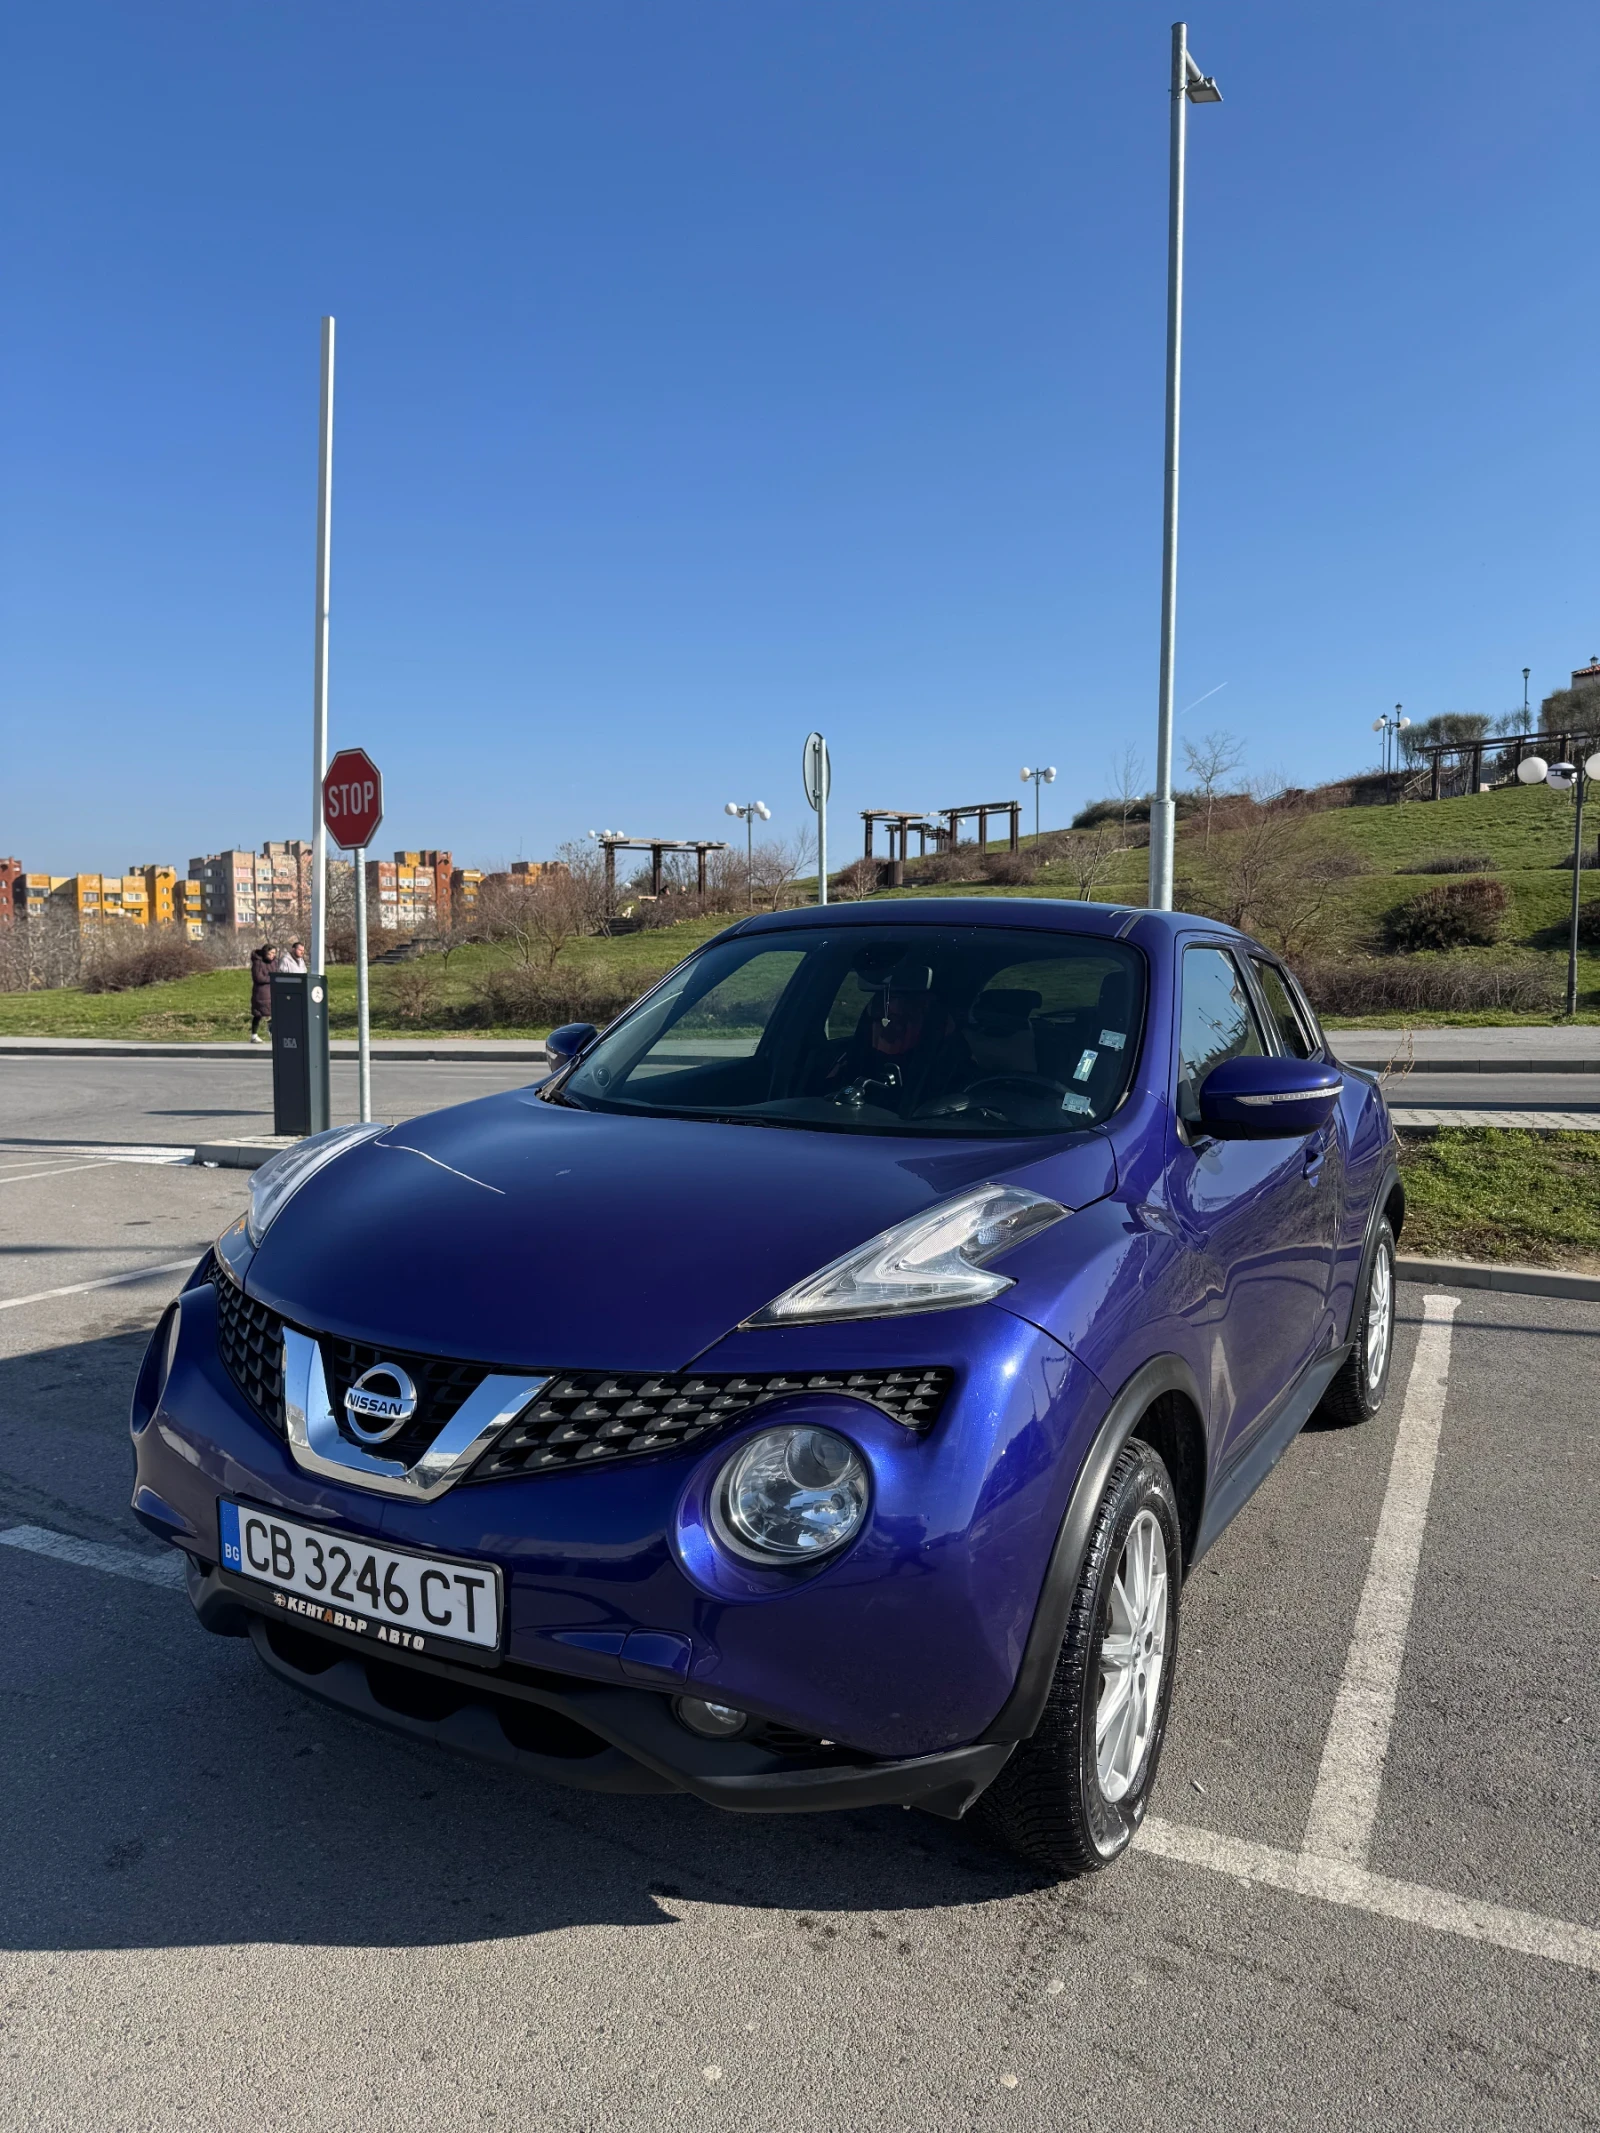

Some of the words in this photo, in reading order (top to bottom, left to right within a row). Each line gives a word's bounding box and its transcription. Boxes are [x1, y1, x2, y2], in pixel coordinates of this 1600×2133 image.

[328, 781, 375, 818] STOP
[346, 1392, 403, 1416] NISSAN
[224, 1542, 240, 1562] BG
[246, 1518, 295, 1581] CB
[305, 1537, 409, 1616] 3246
[420, 1569, 485, 1634] CT
[287, 1596, 368, 1634] КЕНТАВЪР
[377, 1625, 425, 1651] АВТО
